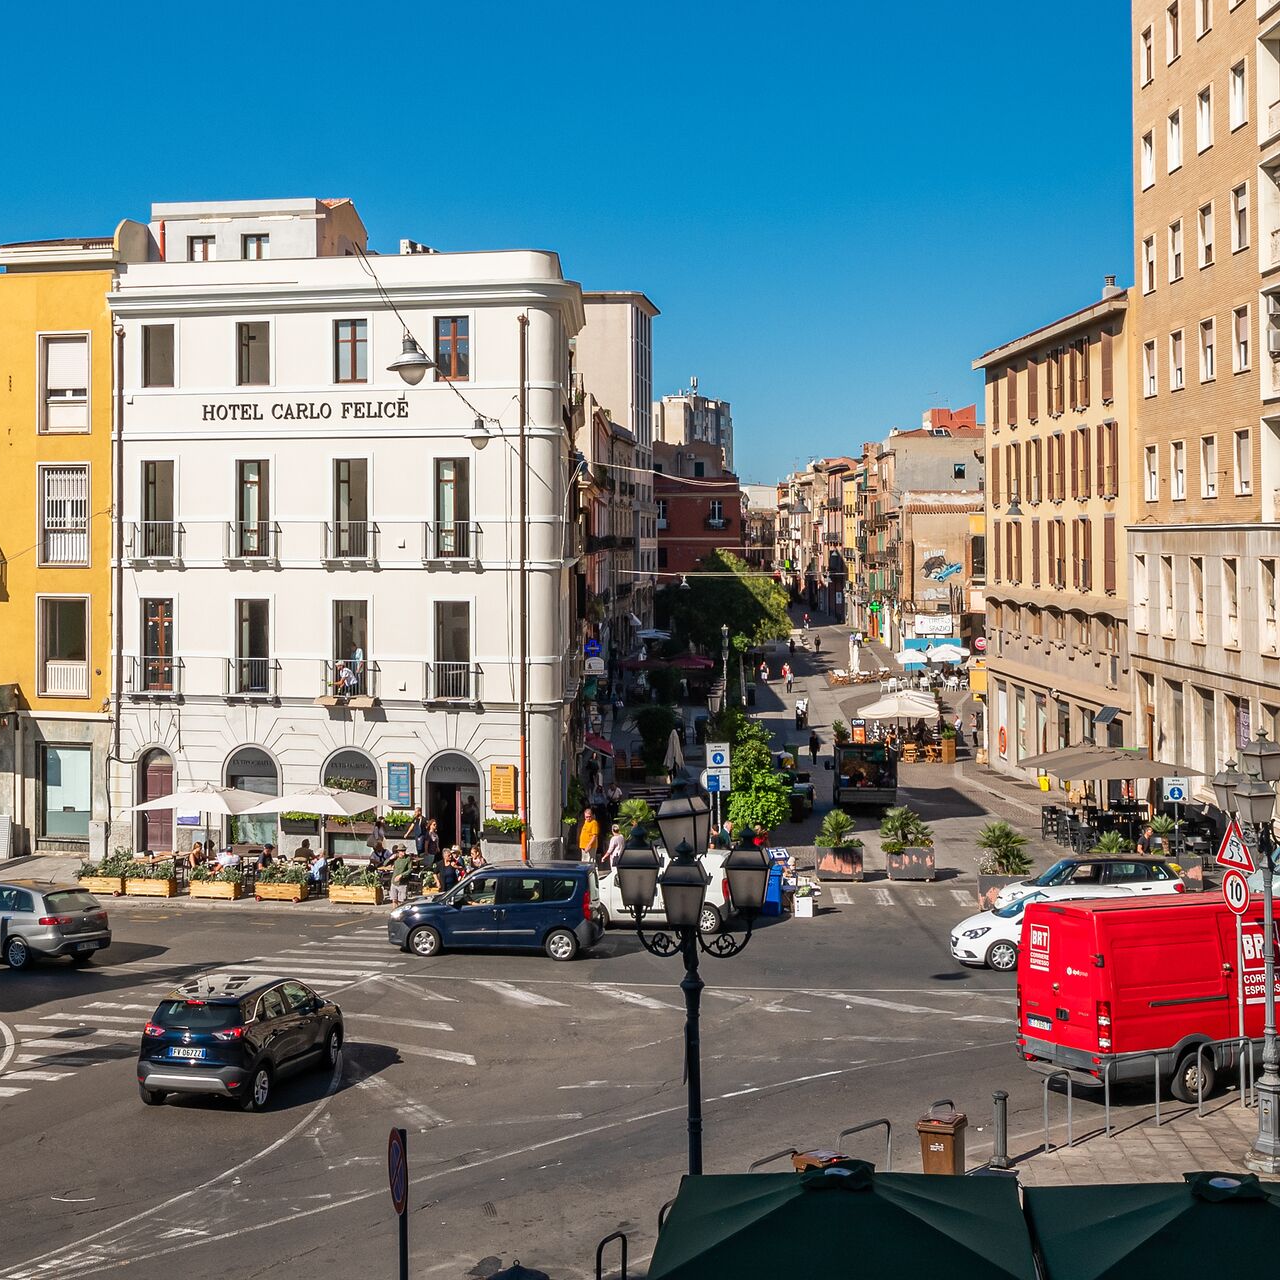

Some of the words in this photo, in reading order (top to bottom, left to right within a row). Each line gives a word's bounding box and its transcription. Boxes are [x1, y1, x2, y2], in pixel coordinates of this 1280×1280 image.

[202, 404, 264, 420] HOTEL
[271, 403, 332, 419] CARLO
[1229, 880, 1243, 903] 10
[1032, 930, 1048, 947] BRT
[1242, 933, 1275, 960] BR
